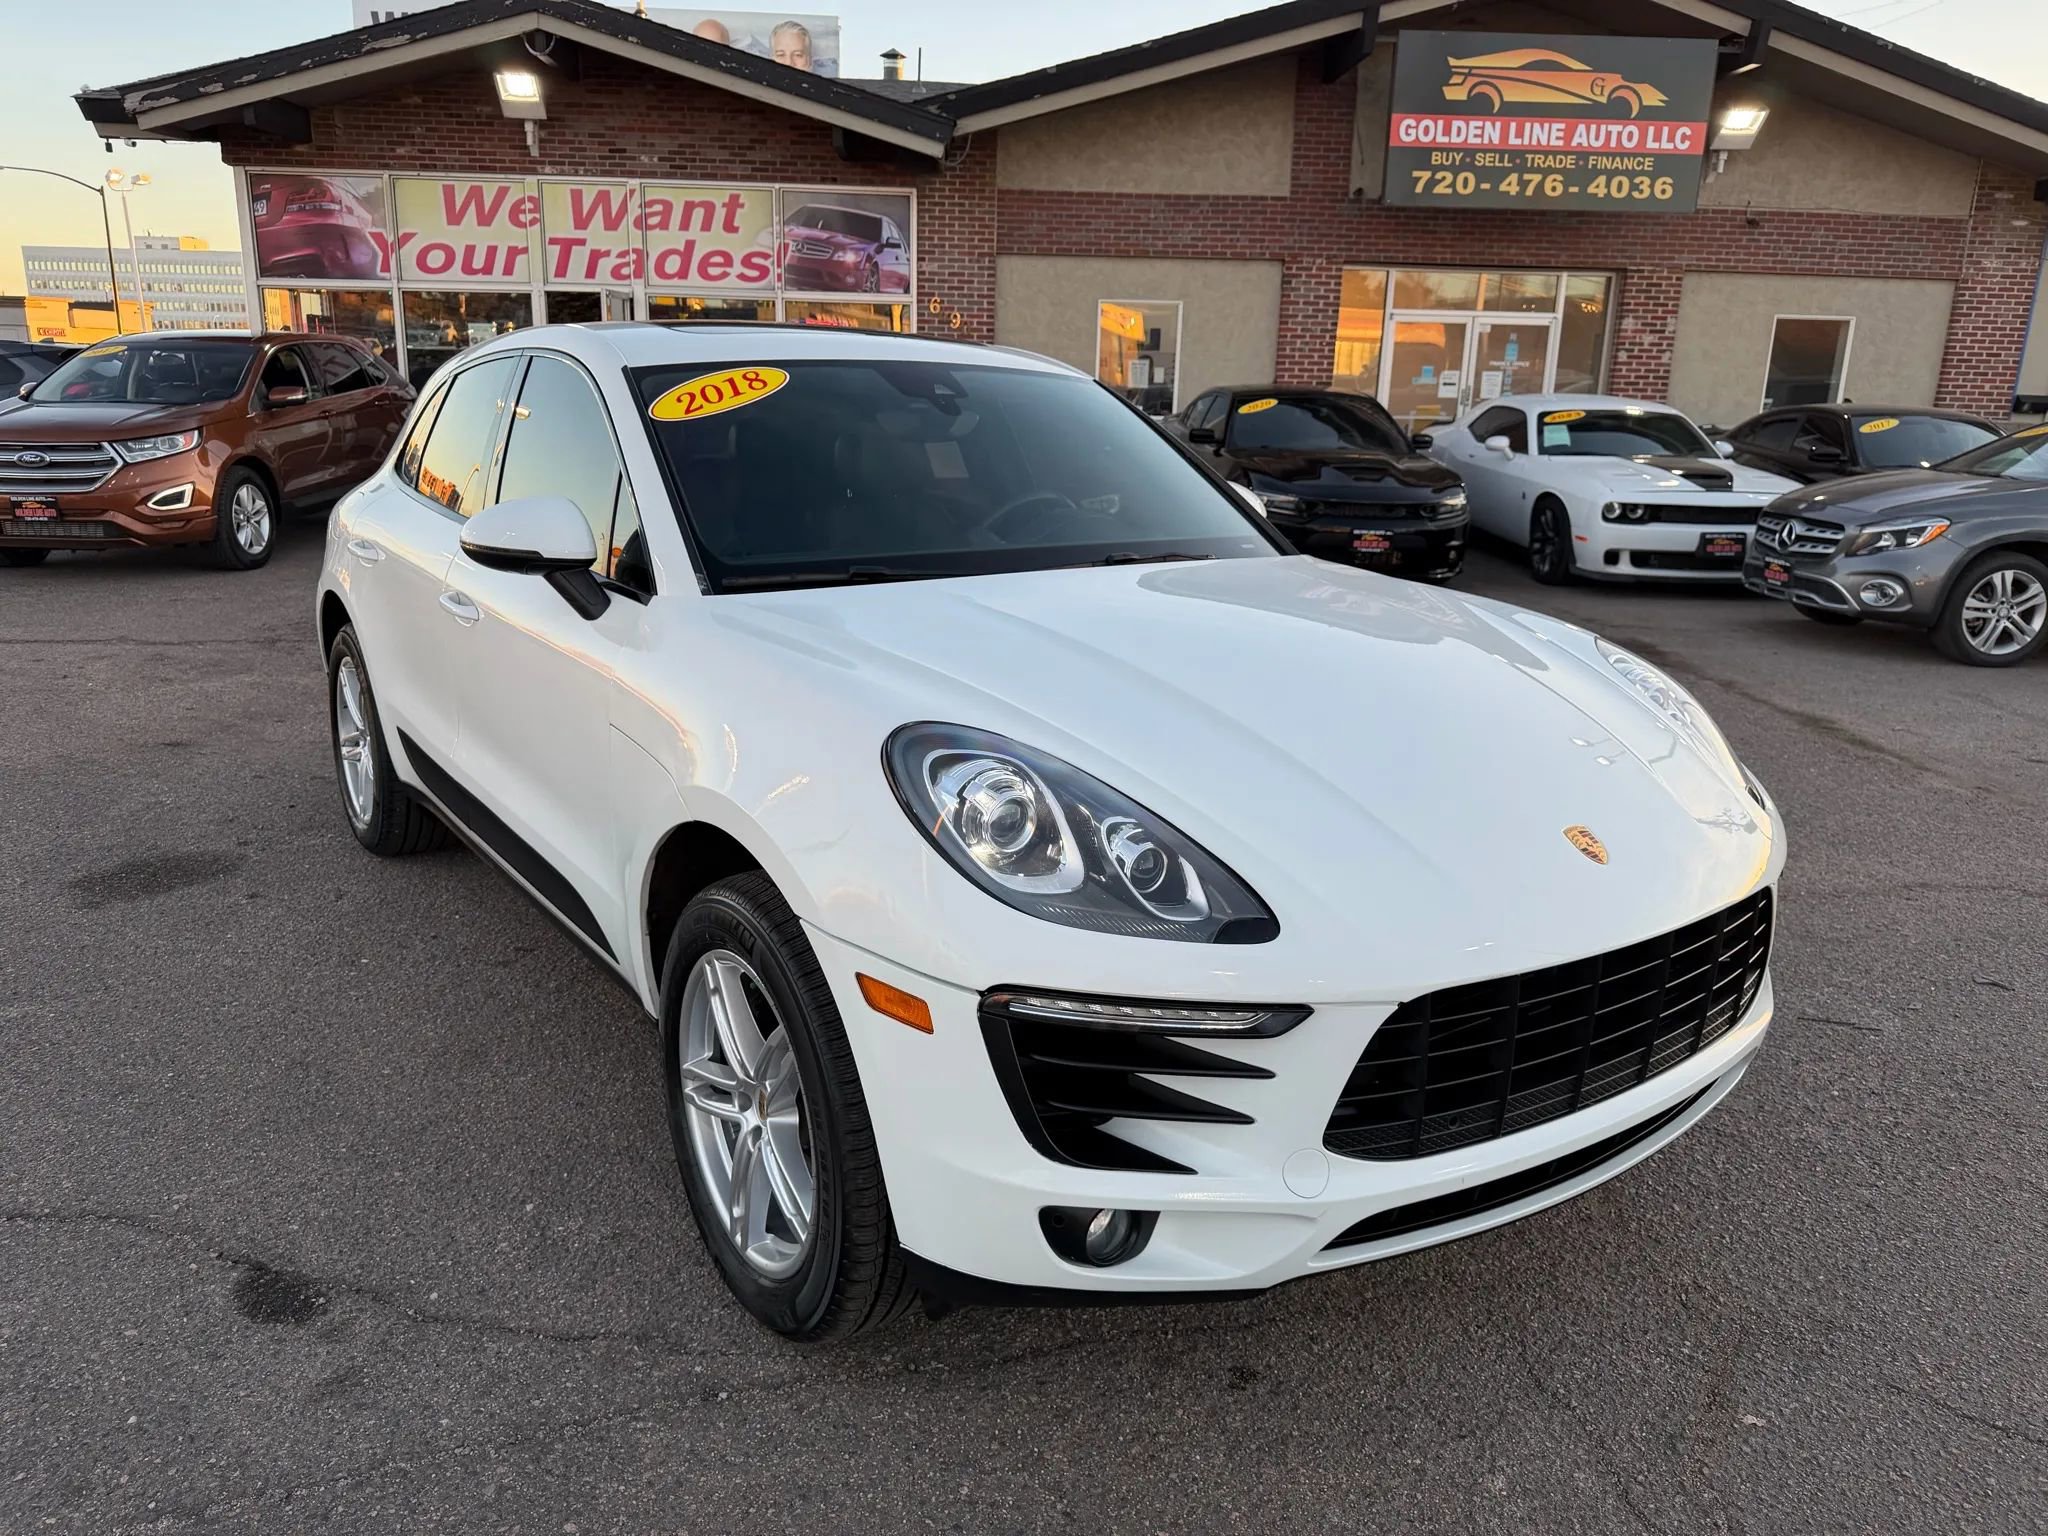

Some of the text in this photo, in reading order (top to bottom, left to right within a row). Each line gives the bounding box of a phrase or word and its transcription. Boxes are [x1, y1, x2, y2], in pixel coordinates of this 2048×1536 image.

[1399, 118, 1692, 150] GOLDEN LINE AUTO LLC
[1431, 152, 1655, 171] BUY SELL TRADE FINANCE
[442, 184, 745, 234] We Want
[368, 231, 789, 283] Your Trades!
[676, 370, 768, 416] 2018
